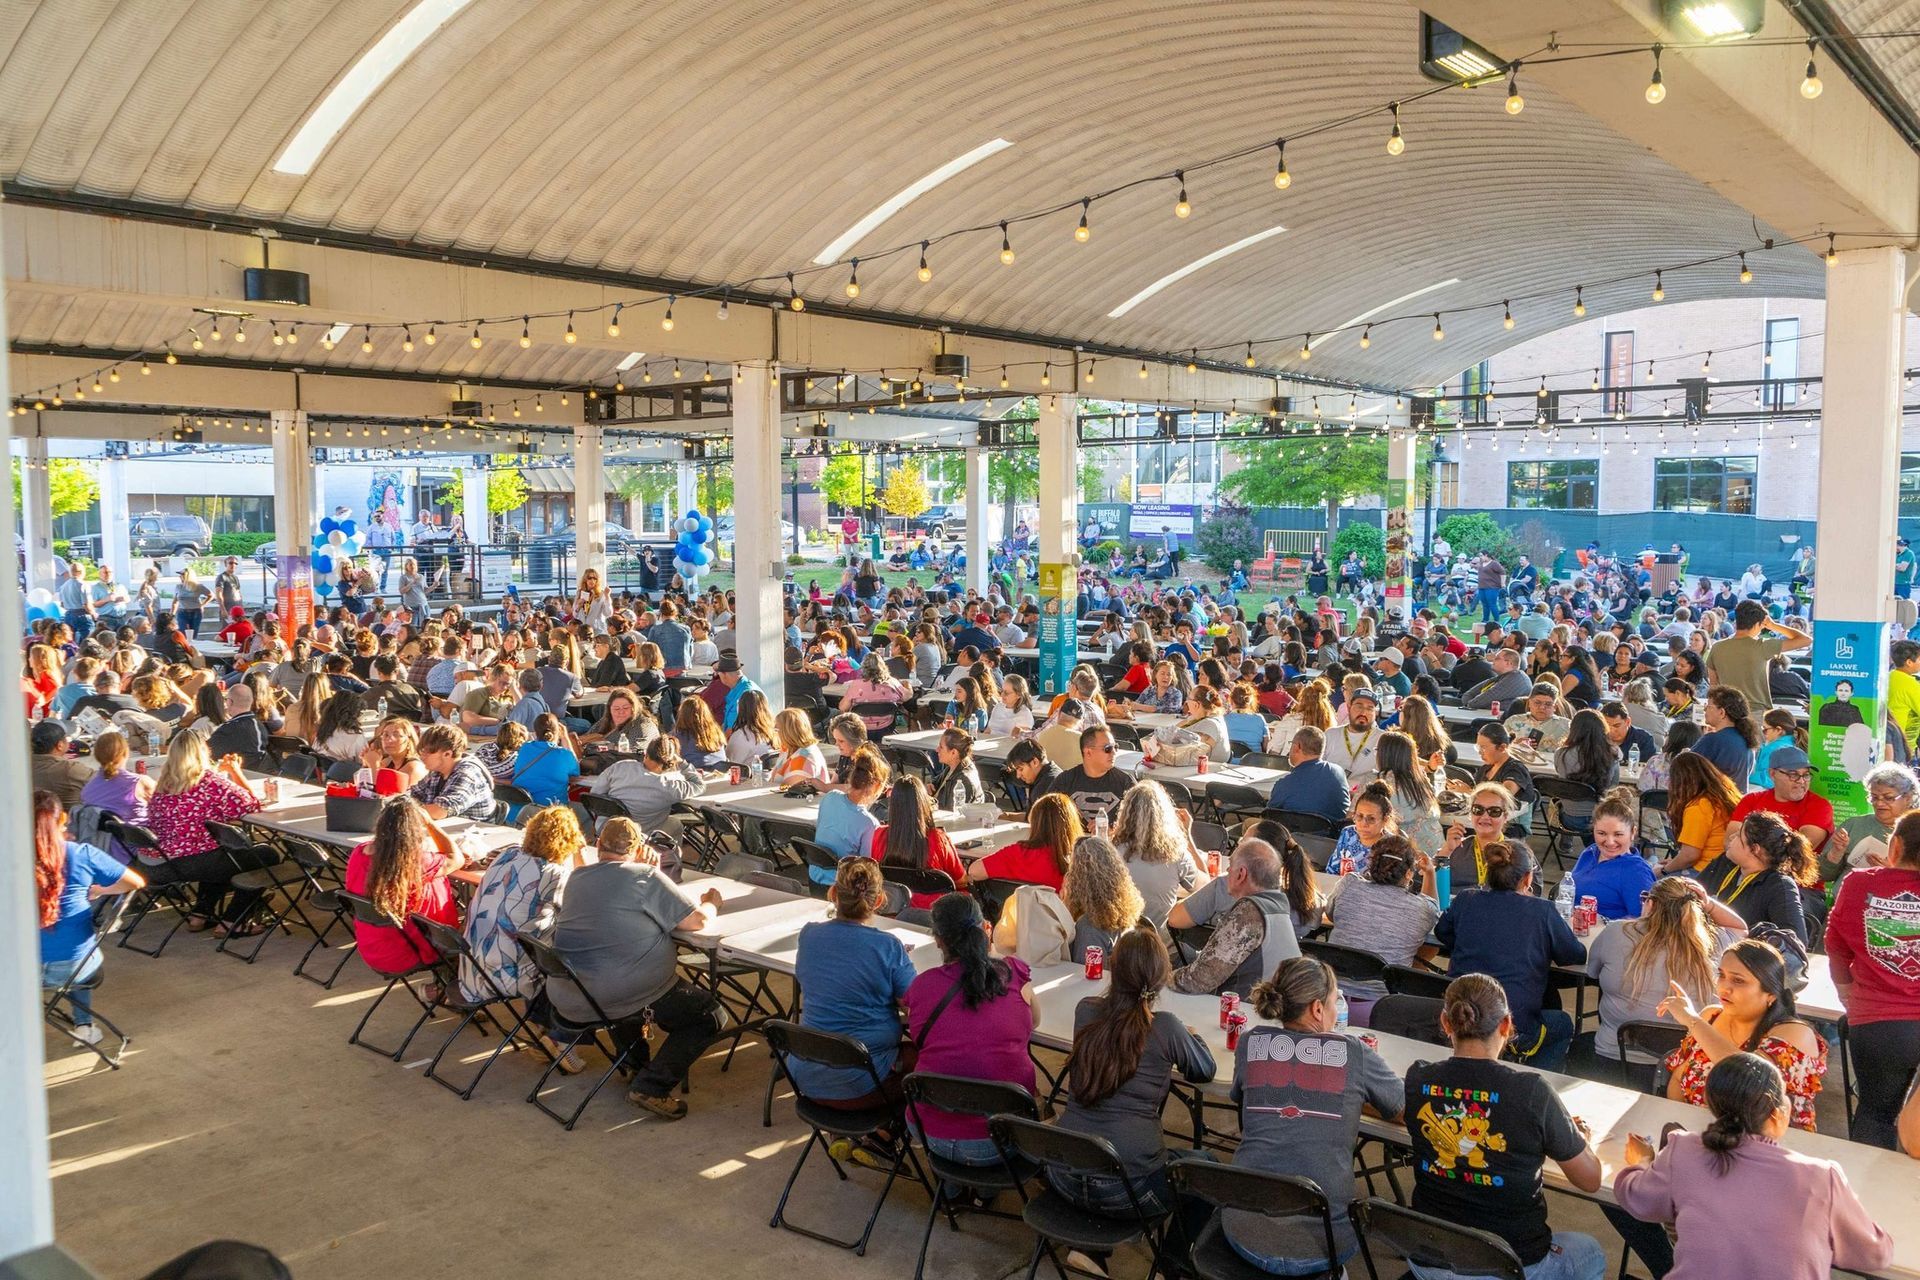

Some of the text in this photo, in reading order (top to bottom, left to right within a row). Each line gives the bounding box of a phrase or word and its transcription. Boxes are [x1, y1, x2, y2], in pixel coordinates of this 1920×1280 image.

[1820, 669, 1869, 678] SPRINGDALE?
[1829, 663, 1858, 671] IAKWE
[1247, 1034, 1348, 1068] HOGS
[1422, 1084, 1500, 1104] HELLSTERN
[1422, 1160, 1505, 1187] BAND HERO
